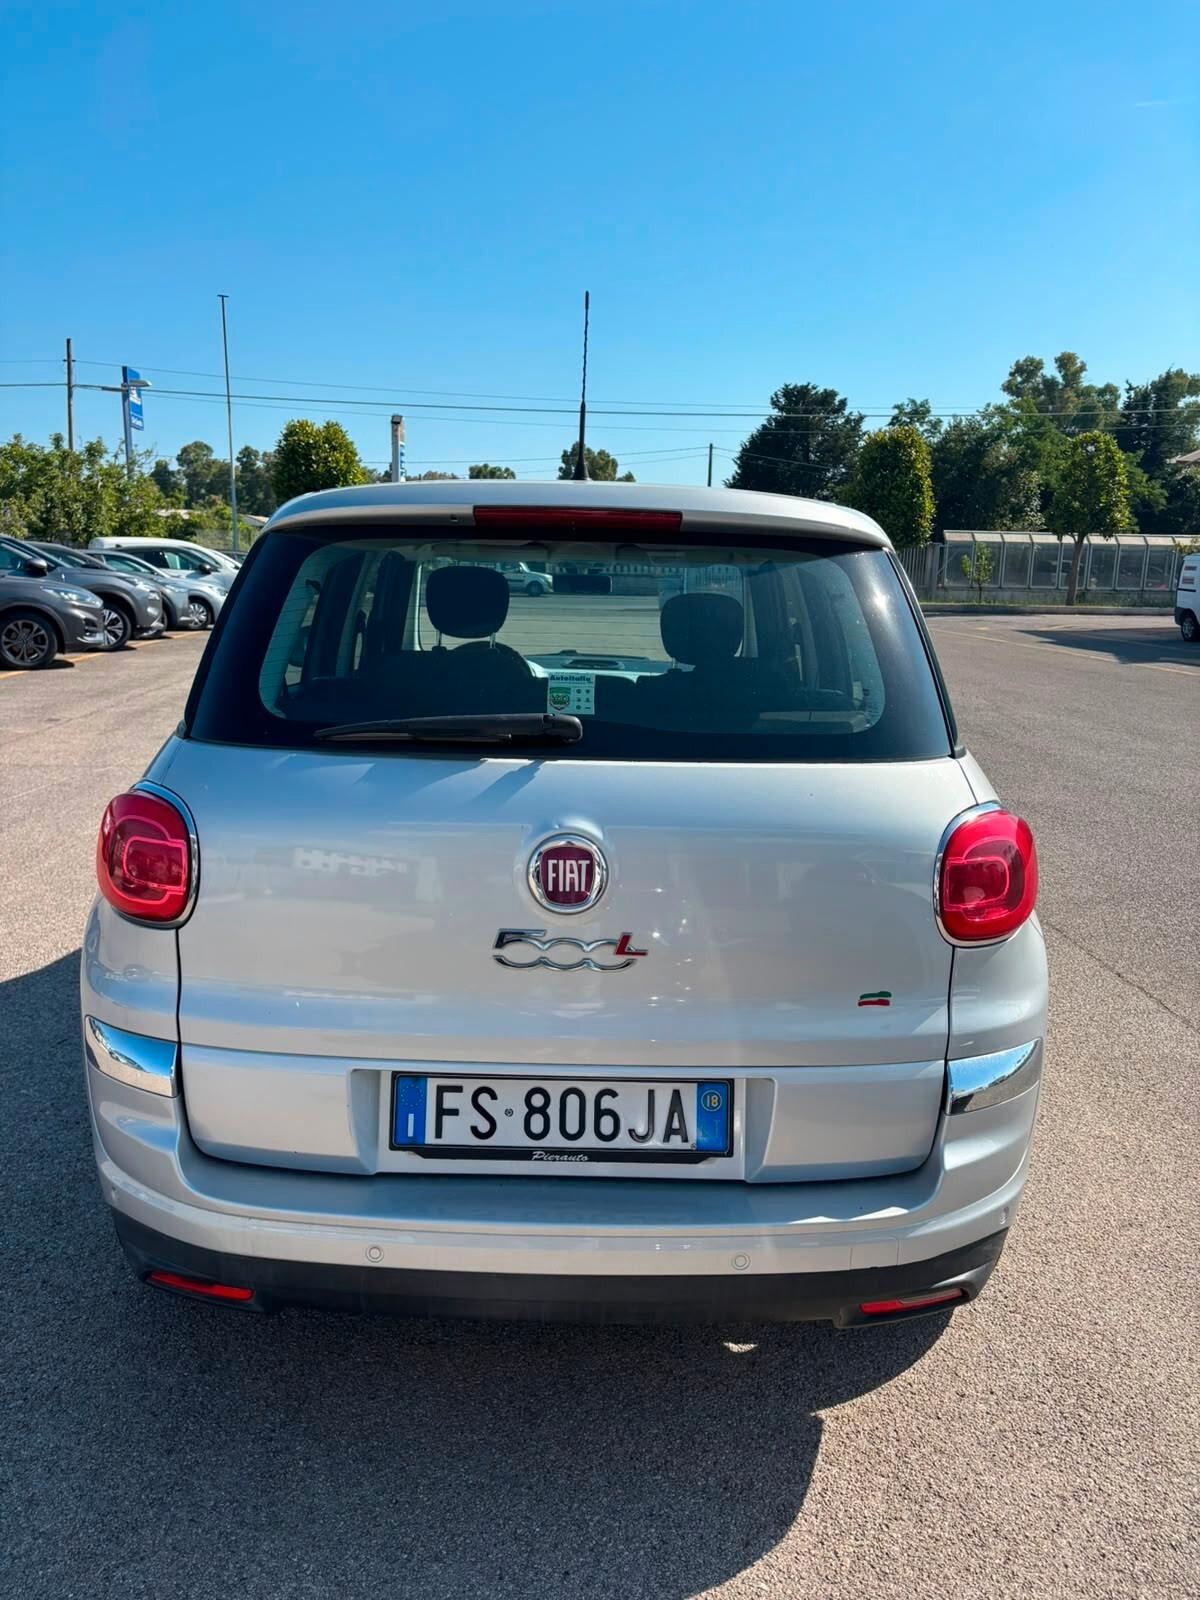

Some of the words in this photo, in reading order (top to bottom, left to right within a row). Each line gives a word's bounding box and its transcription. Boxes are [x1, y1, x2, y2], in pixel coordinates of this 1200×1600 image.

[547, 859, 591, 892] FIAT
[493, 928, 648, 971] 500L
[434, 1085, 499, 1140] FS
[706, 1094, 719, 1108] 18
[407, 1113, 415, 1137] I
[531, 1151, 590, 1162] Pierauto
